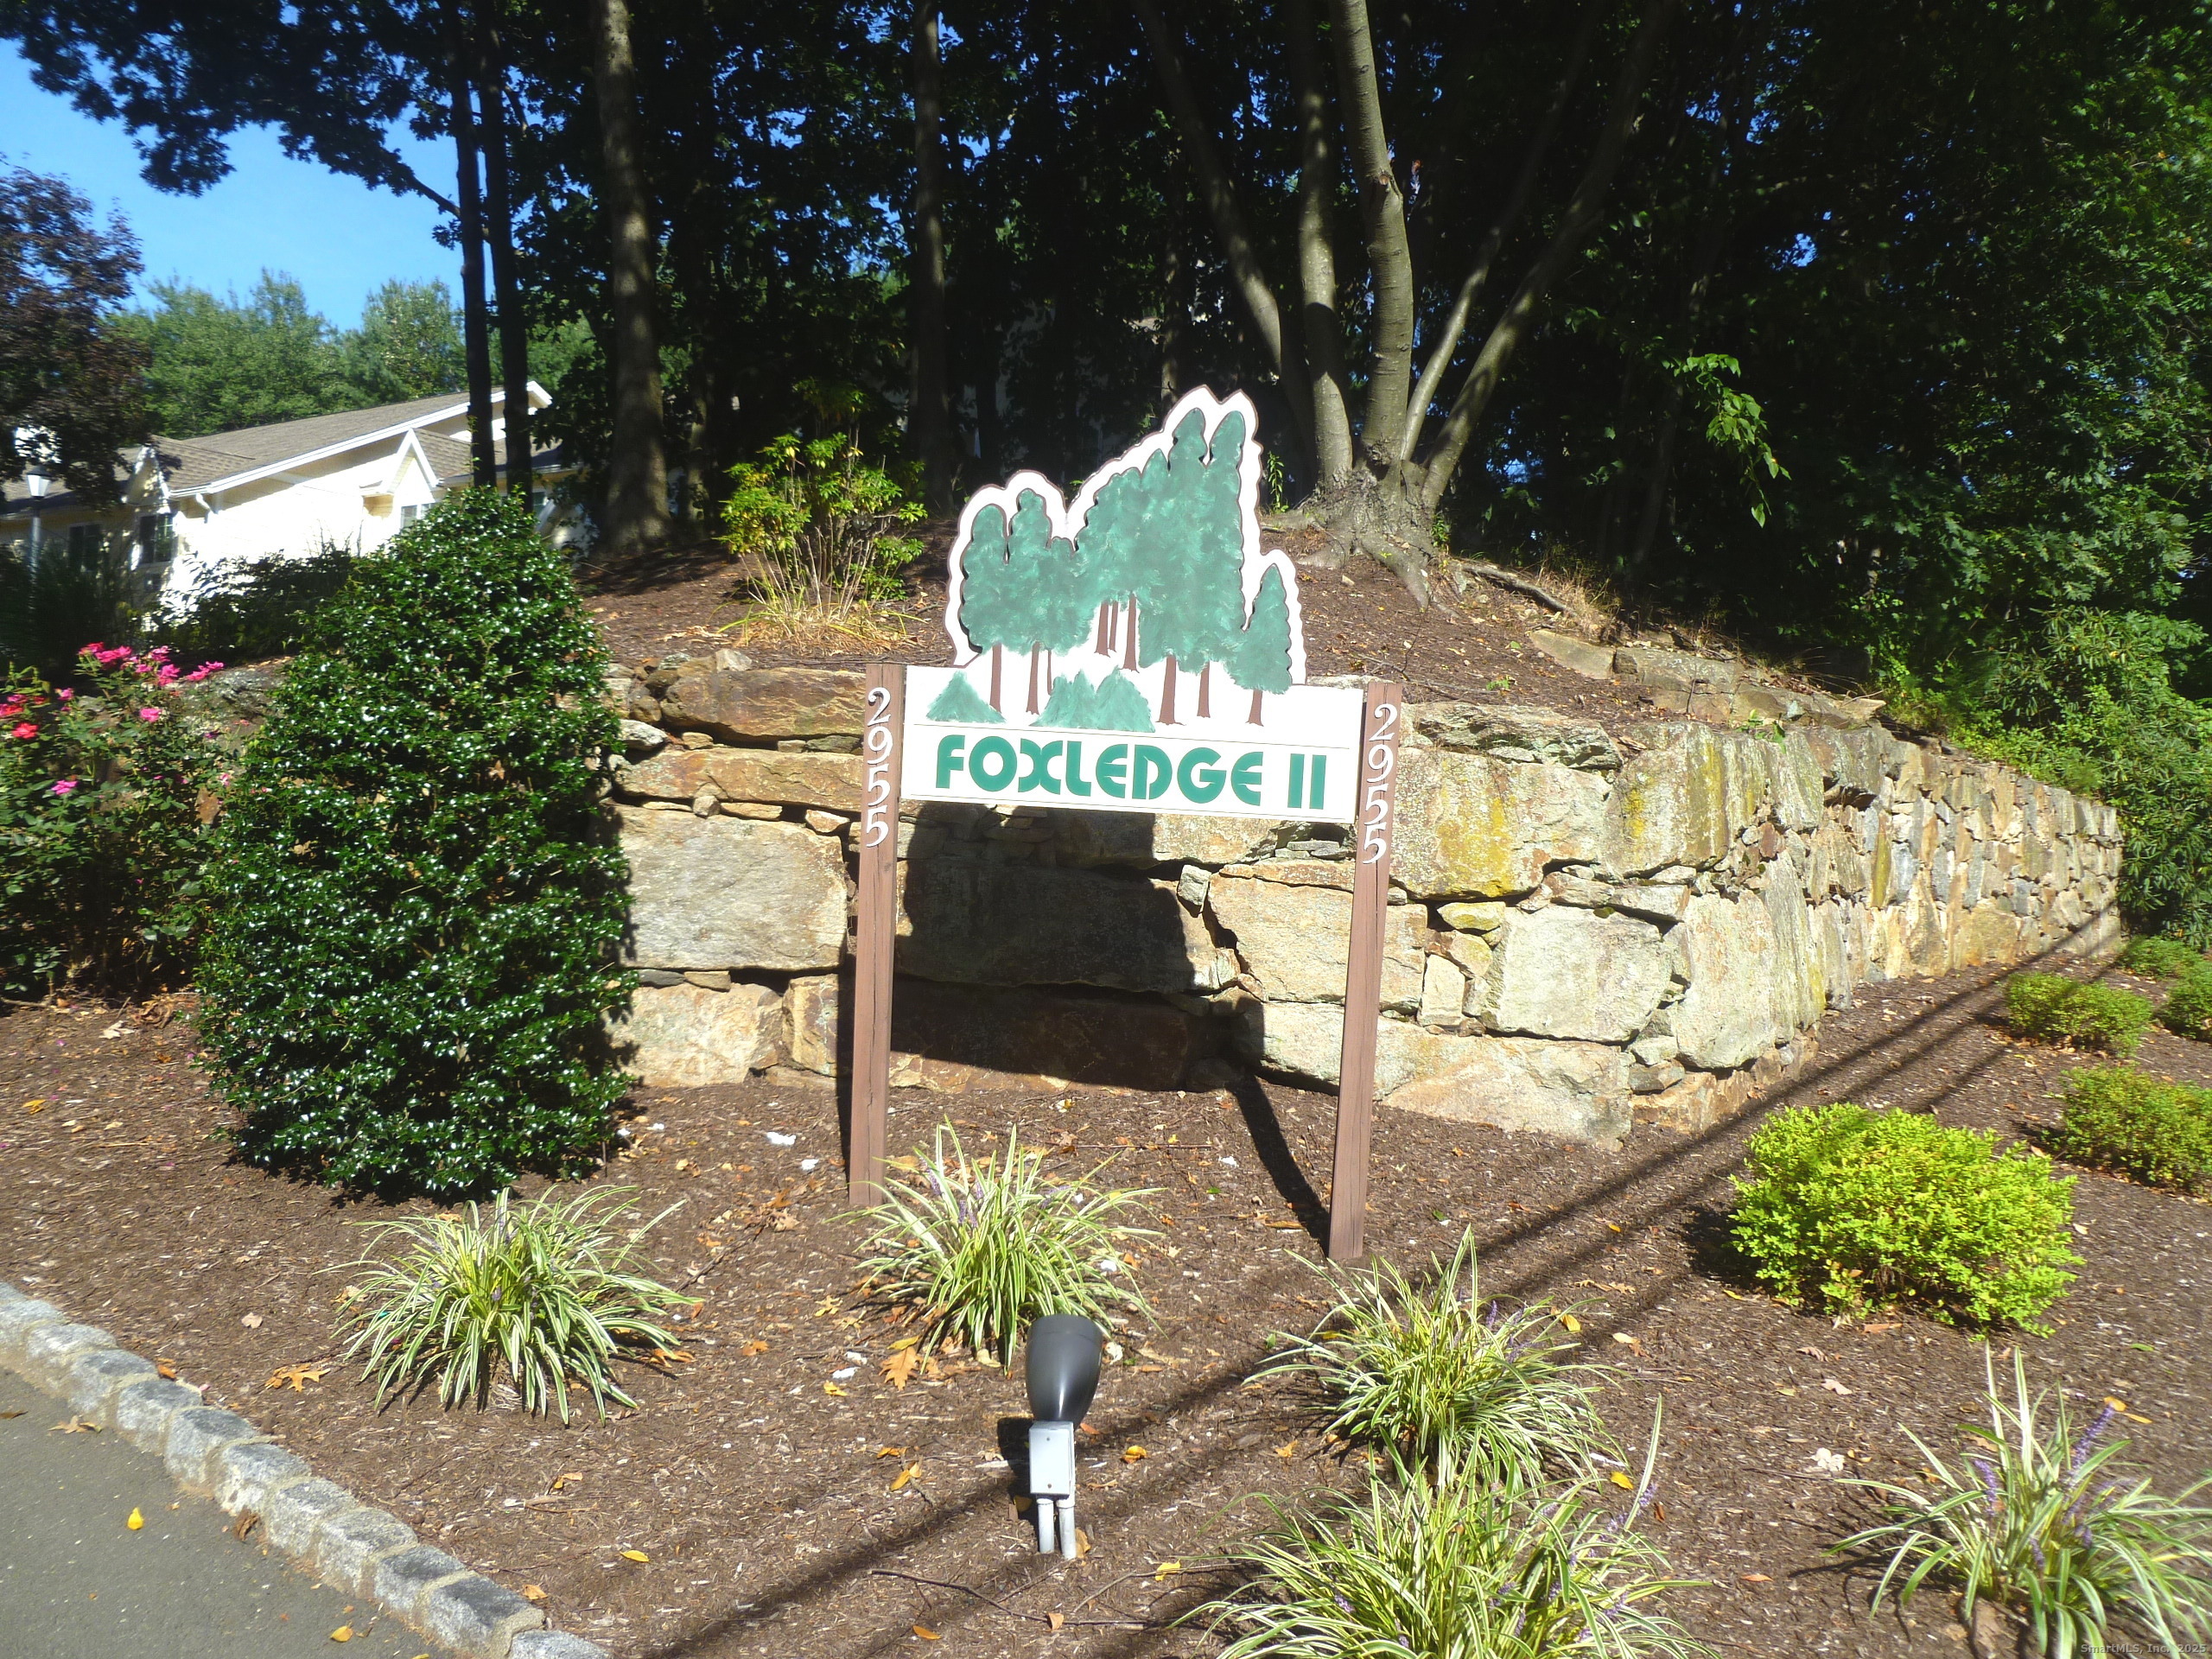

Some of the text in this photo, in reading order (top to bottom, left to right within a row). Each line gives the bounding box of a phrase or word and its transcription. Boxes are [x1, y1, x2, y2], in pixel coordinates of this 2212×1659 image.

[866, 687, 893, 848] 2955
[935, 734, 1326, 810] FOXLEDGE II
[1362, 703, 1397, 864] 2955
